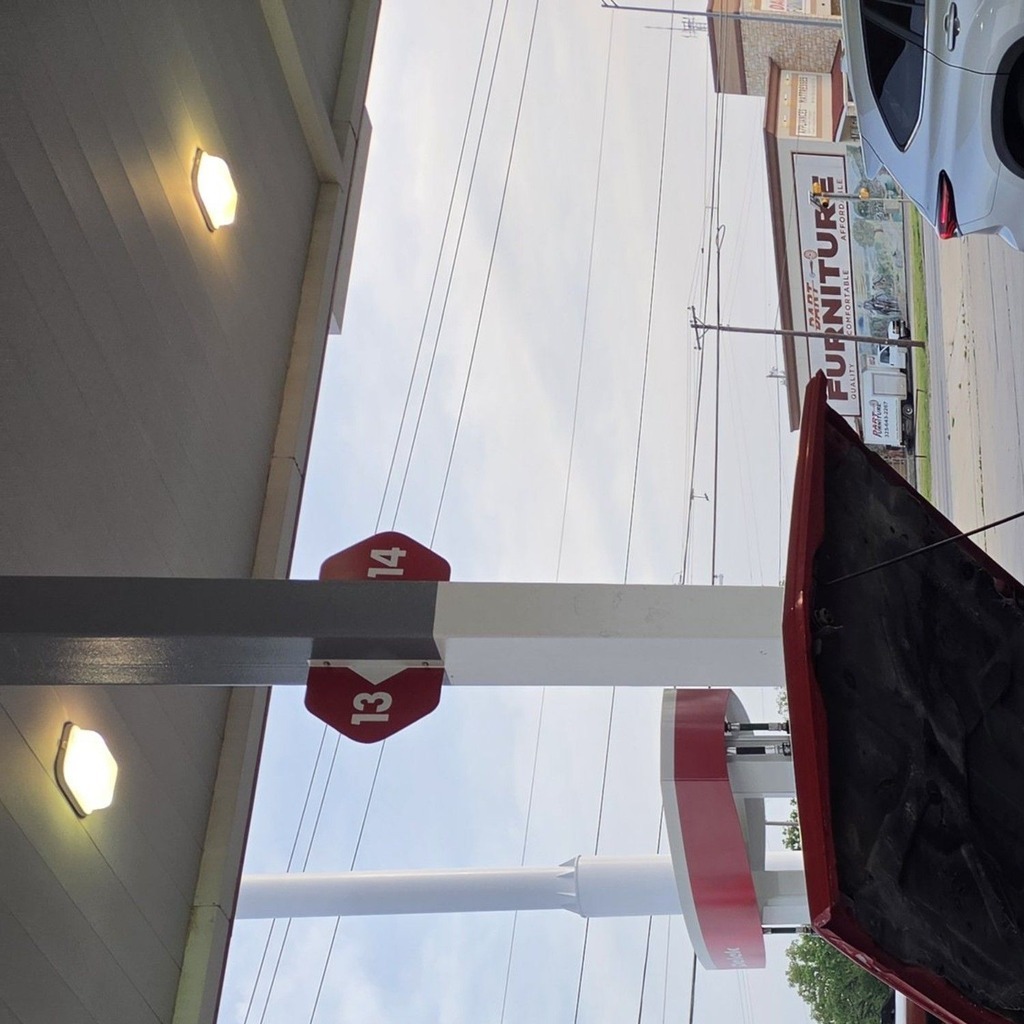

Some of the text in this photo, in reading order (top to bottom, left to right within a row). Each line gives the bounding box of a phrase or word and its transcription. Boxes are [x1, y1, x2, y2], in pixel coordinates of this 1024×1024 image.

[836, 179, 847, 241] AFFORDLE
[806, 281, 821, 331] DART
[811, 176, 848, 401] FURNITURE
[842, 269, 853, 335] COMFORTABLE
[848, 363, 857, 400] QUALITY
[367, 547, 407, 578] 14
[351, 691, 393, 725] 13
